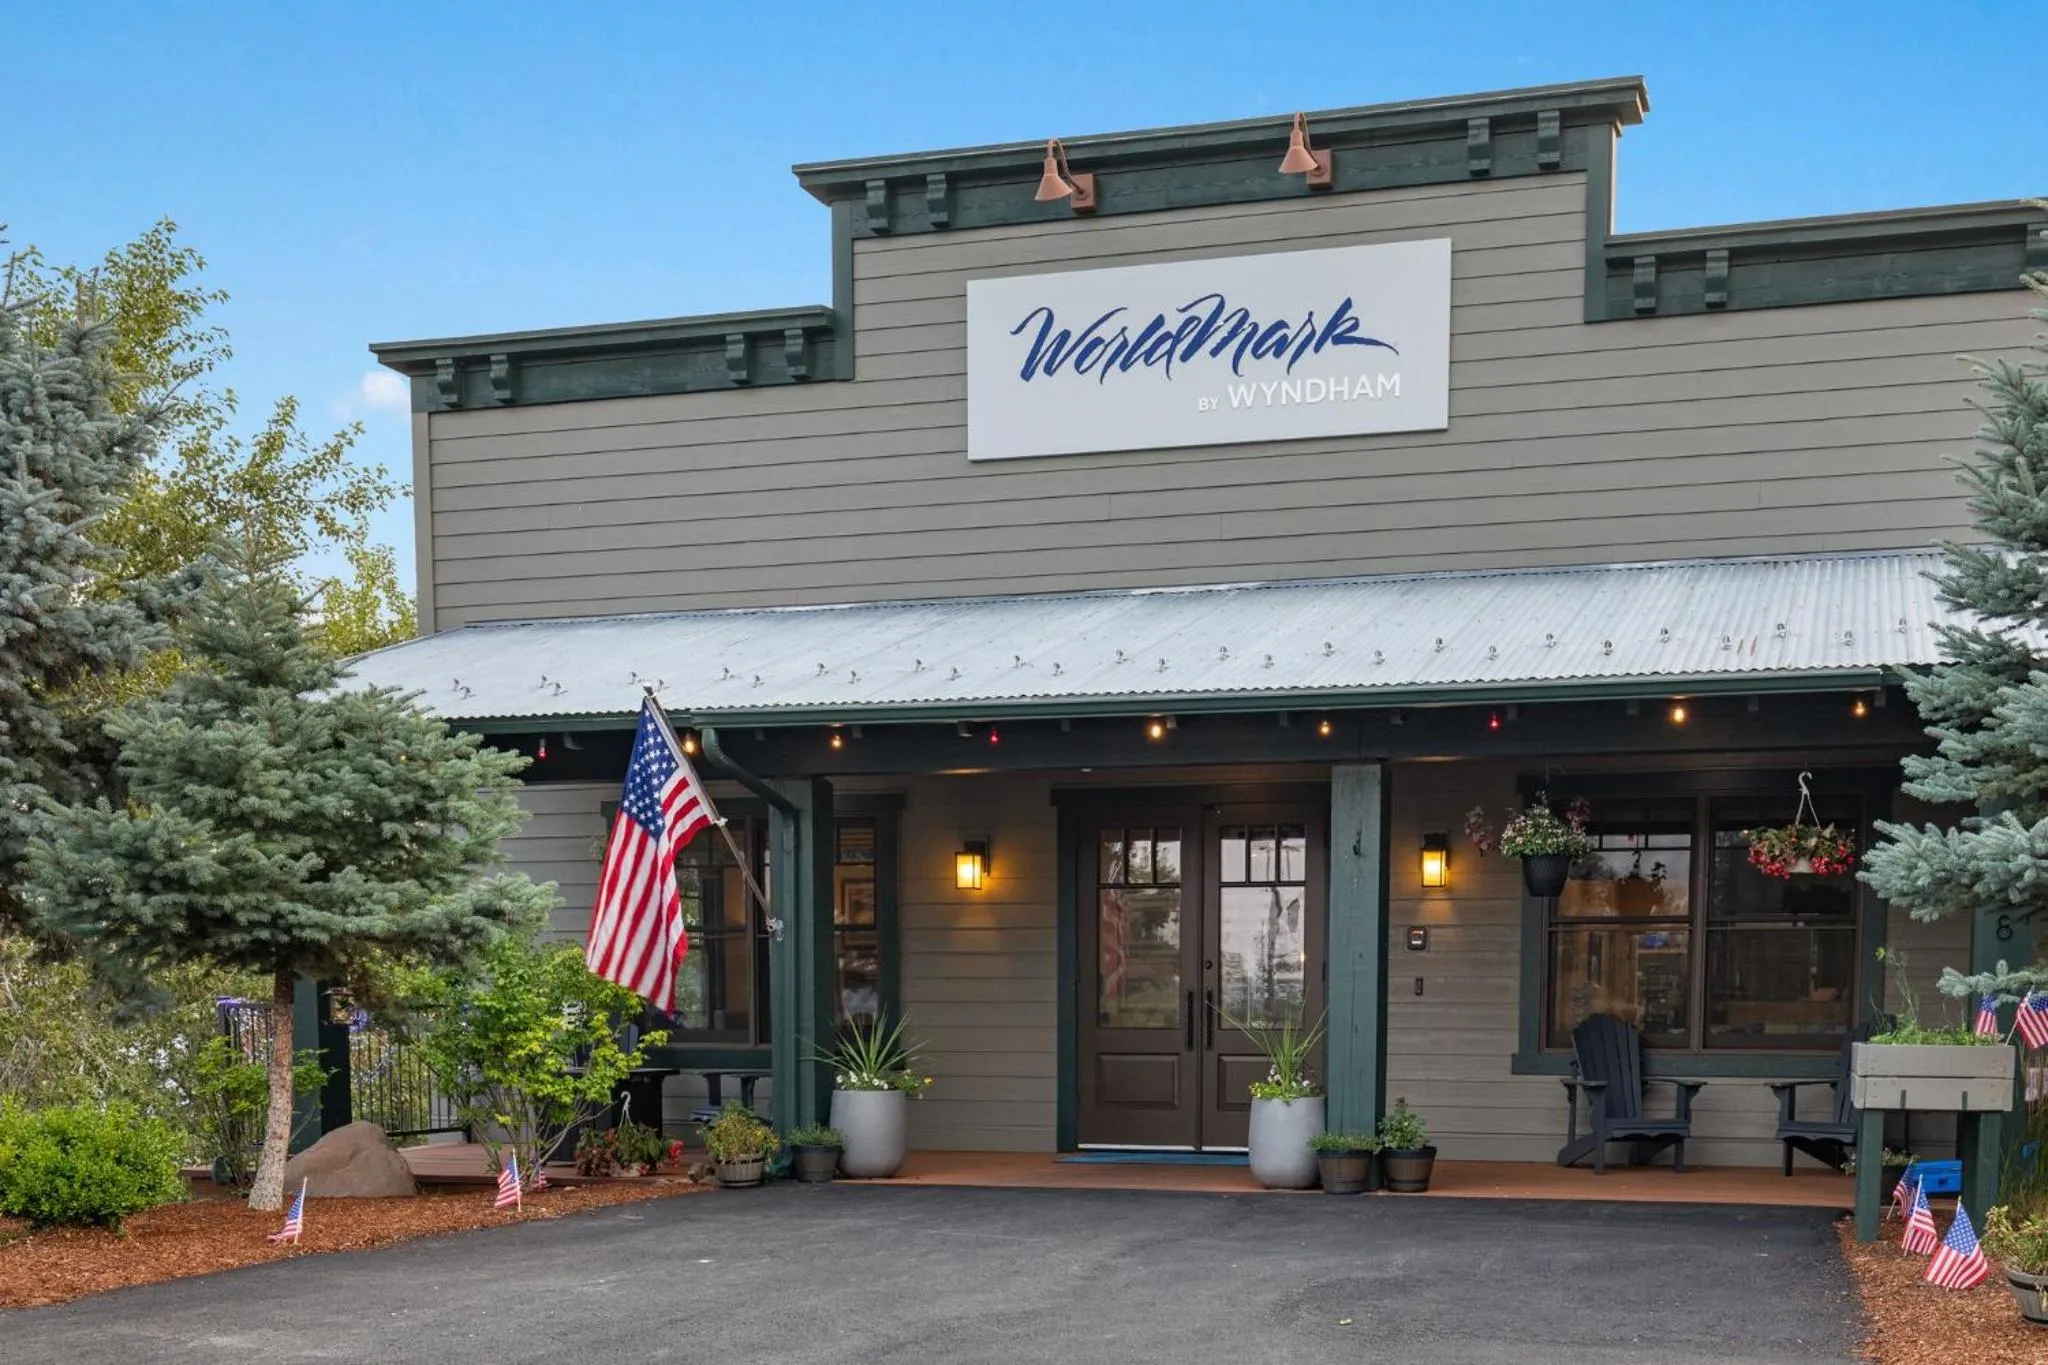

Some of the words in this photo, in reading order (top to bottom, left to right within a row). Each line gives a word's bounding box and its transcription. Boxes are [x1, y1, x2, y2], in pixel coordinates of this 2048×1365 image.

[1010, 294, 1399, 384] WorldMark
[1199, 396, 1220, 412] BY
[1228, 372, 1401, 409] WYNDHAM
